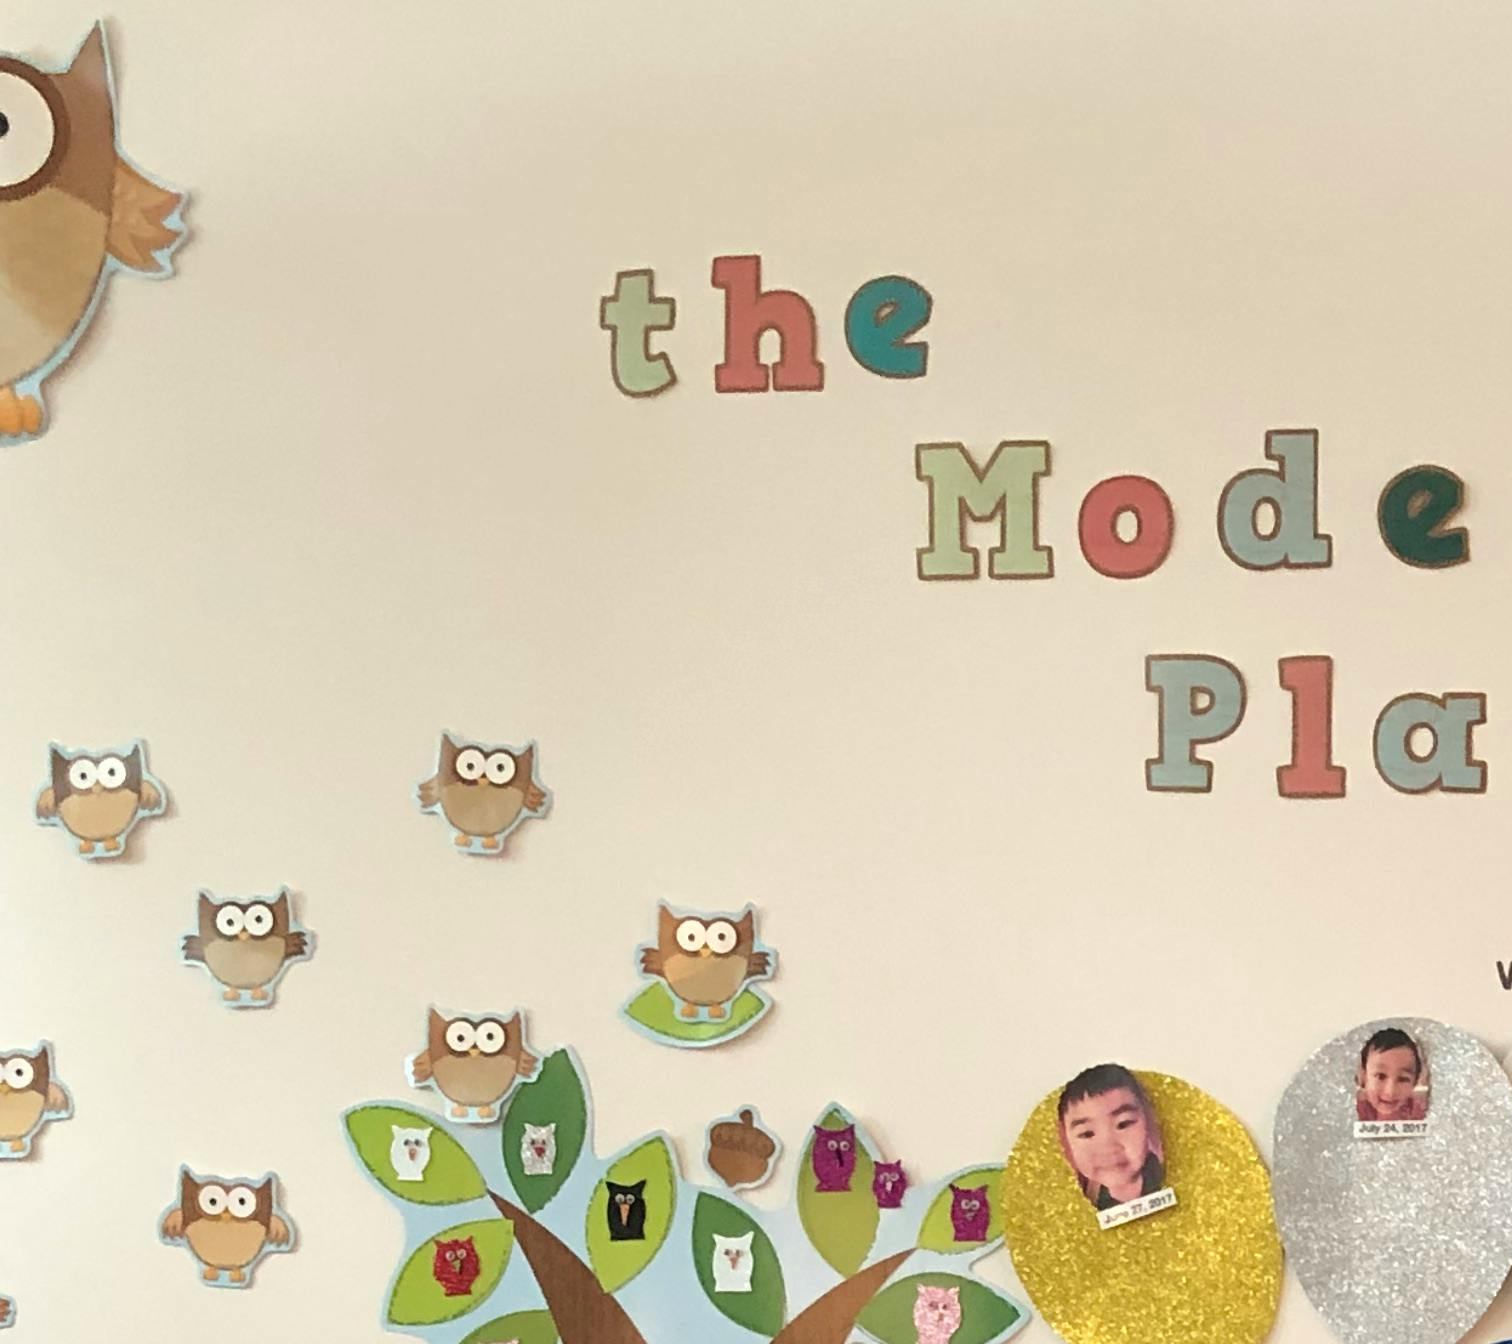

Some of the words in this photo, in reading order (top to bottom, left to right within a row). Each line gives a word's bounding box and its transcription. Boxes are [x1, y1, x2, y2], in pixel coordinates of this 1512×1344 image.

[602, 254, 934, 398] the
[1358, 1122, 1382, 1135] July
[1403, 1121, 1429, 1134] 2017
[1149, 1192, 1173, 1210] 2017
